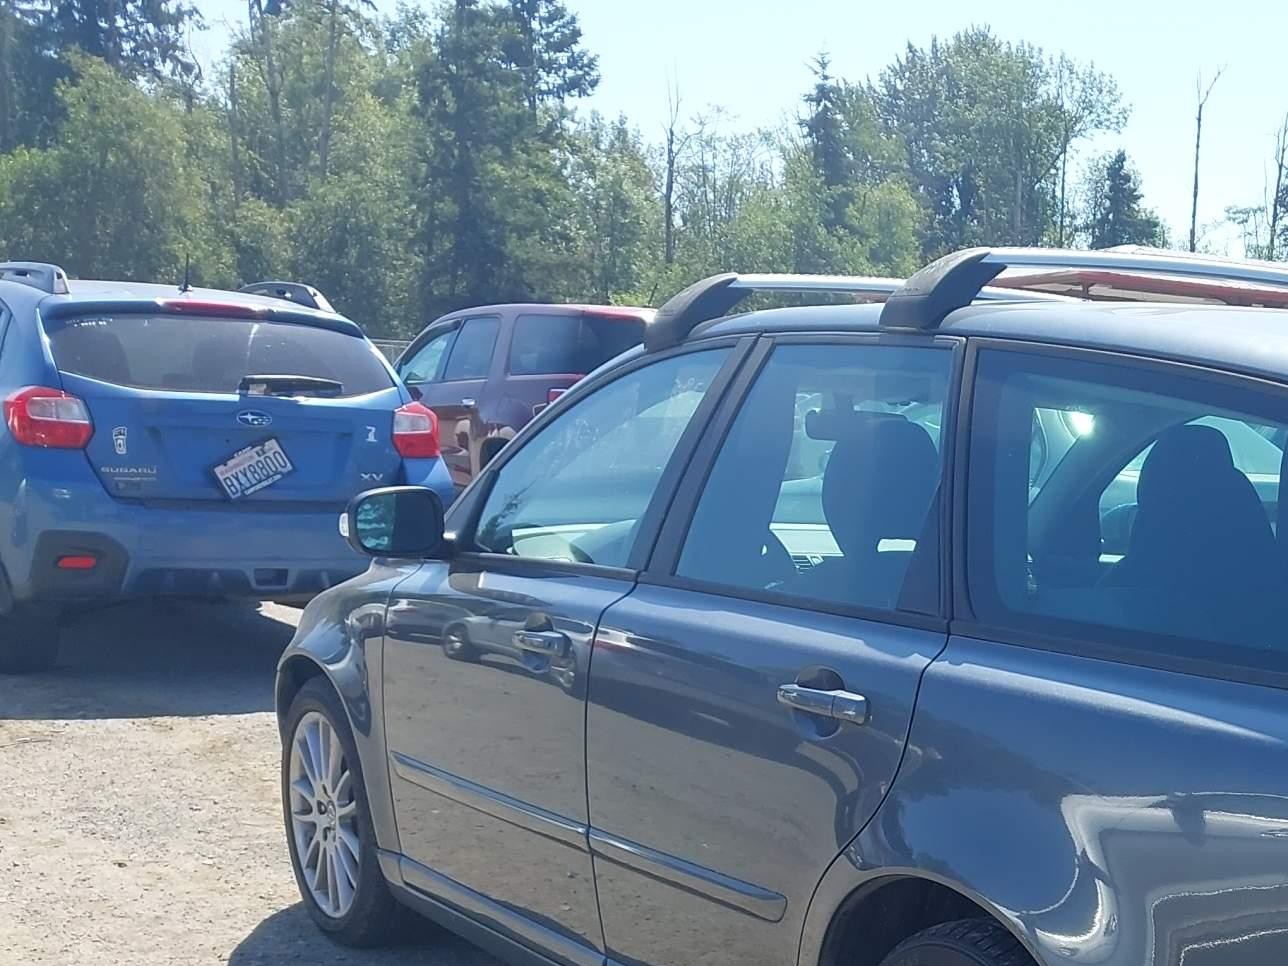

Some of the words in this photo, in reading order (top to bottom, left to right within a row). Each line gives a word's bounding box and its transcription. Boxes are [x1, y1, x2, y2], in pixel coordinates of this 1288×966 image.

[100, 465, 158, 474] SUBARU
[222, 450, 288, 496] BXY8800
[360, 472, 384, 481] XV
